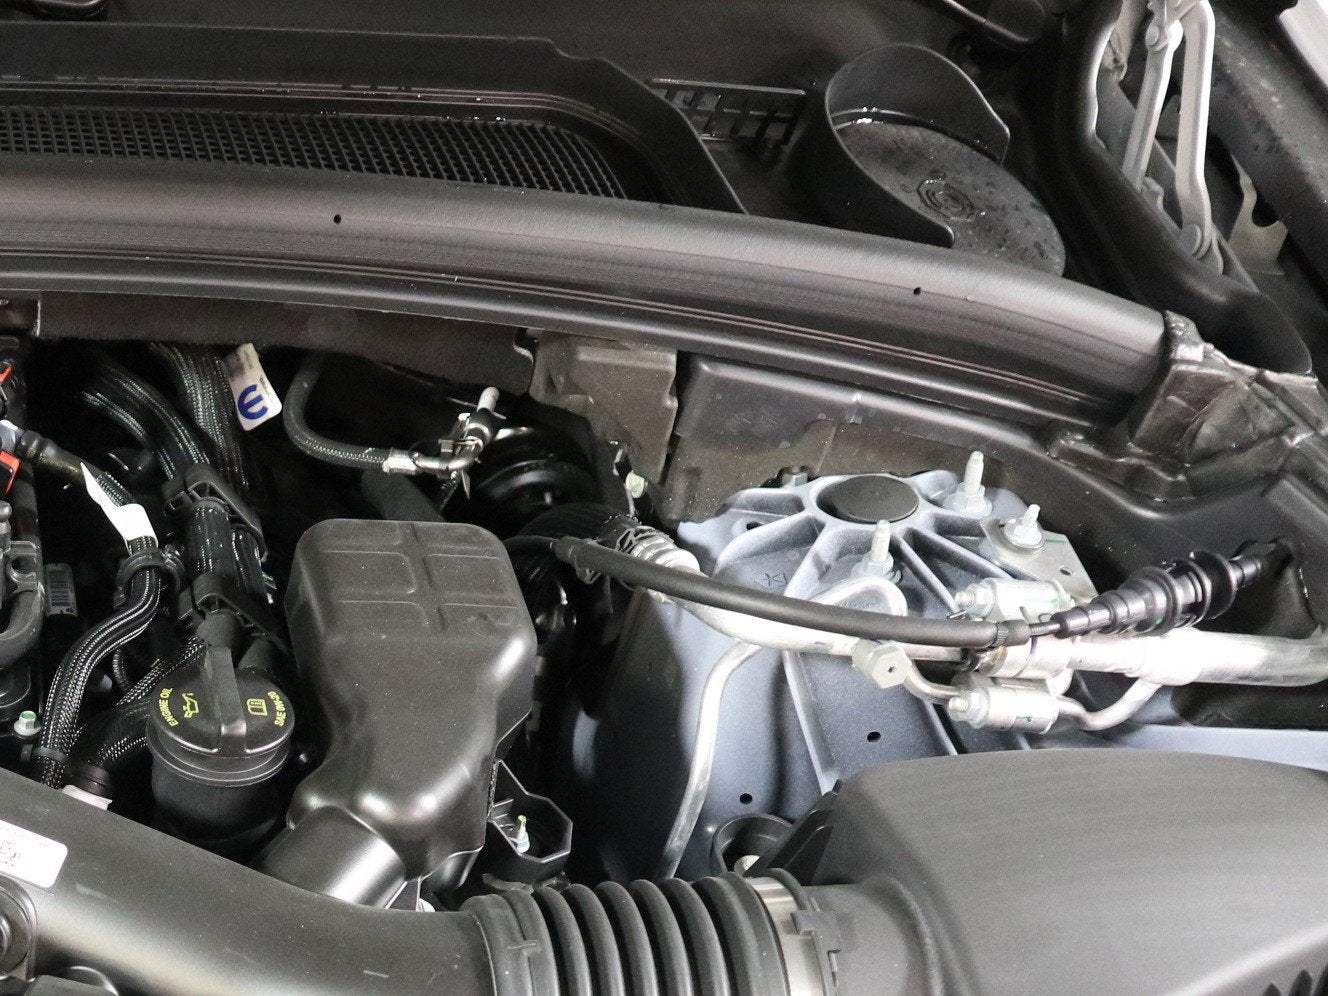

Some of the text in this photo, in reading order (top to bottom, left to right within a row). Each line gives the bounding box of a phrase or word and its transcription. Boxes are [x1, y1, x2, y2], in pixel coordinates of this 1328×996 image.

[159, 687, 179, 727] ENGINE OIL
[267, 691, 287, 727] SAE 0W-20
